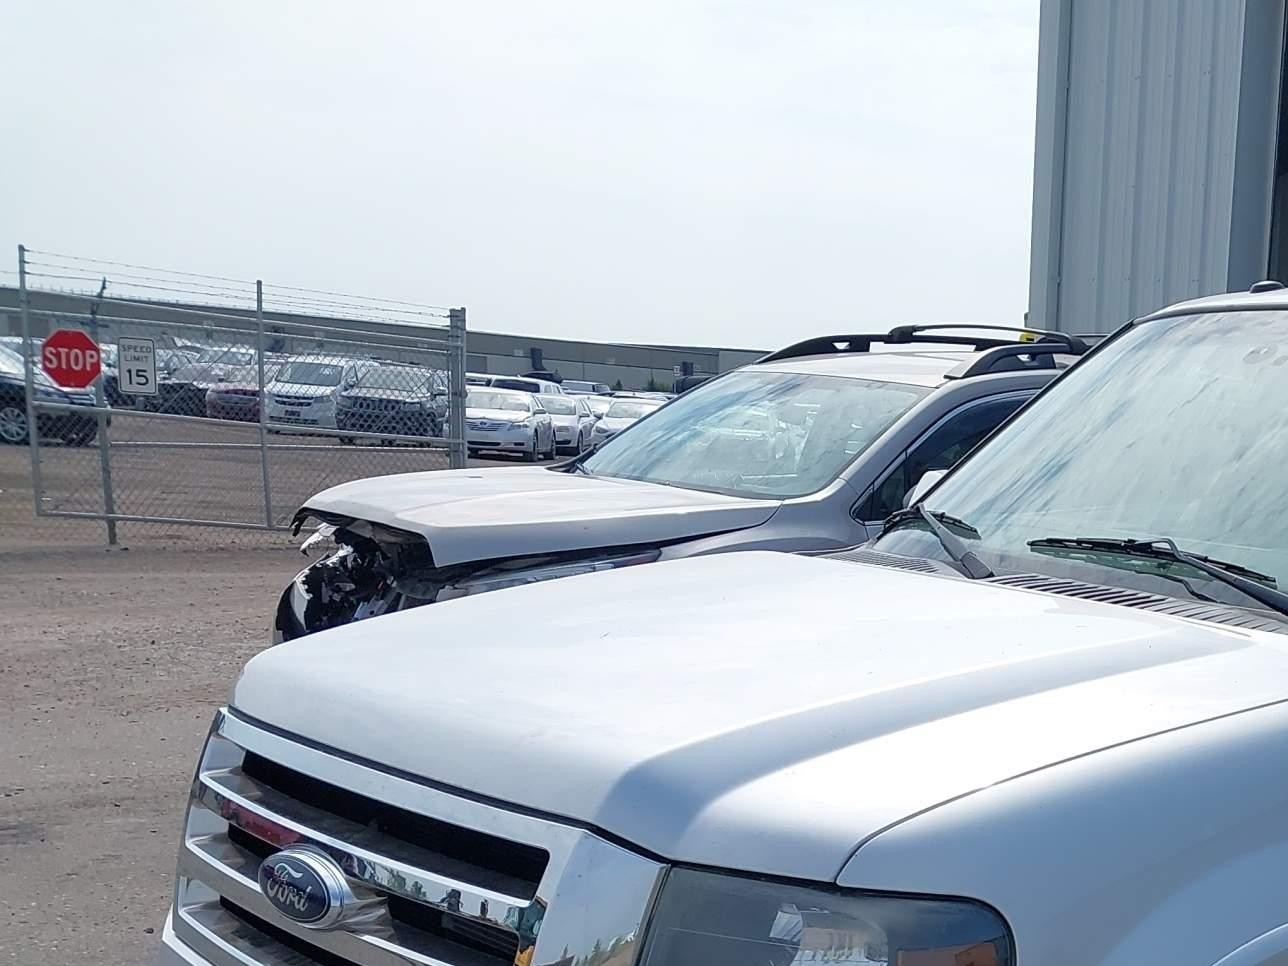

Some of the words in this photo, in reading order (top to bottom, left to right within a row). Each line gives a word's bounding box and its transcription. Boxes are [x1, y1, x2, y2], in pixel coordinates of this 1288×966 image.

[121, 345, 152, 353] SPEED
[45, 347, 99, 371] STOP
[124, 354, 149, 363] LIMIT
[126, 368, 149, 386] 15
[267, 863, 312, 911] Ford
